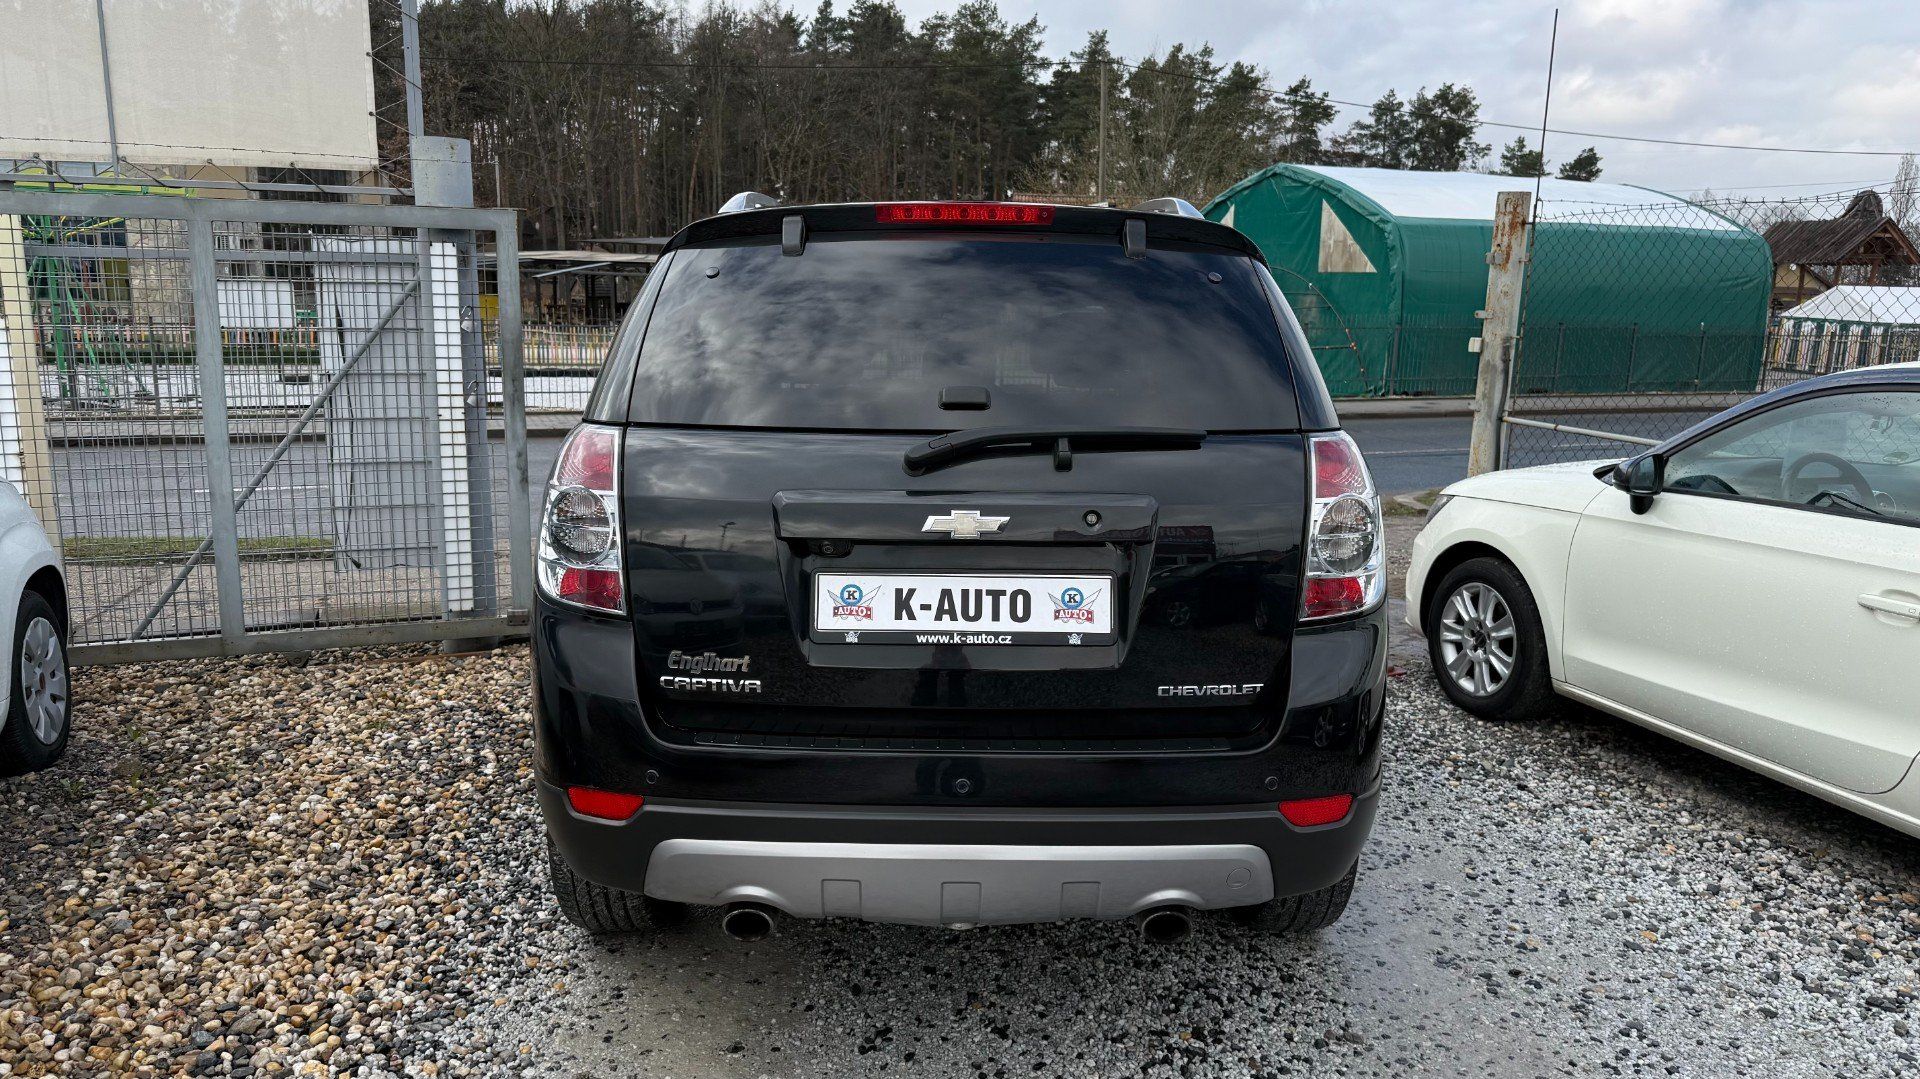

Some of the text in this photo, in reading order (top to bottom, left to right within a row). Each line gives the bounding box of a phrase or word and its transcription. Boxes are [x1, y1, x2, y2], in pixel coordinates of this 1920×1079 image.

[845, 590, 858, 600] K
[1066, 593, 1079, 604] K
[837, 606, 867, 616] AUTO
[894, 587, 1032, 623] K-AUTO
[1058, 609, 1088, 619] AUTO
[916, 632, 1012, 644] www.k-auto.cz
[667, 650, 751, 674] Englhart
[660, 676, 762, 693] CAPTIVA
[1157, 683, 1264, 697] CHEVROLET
